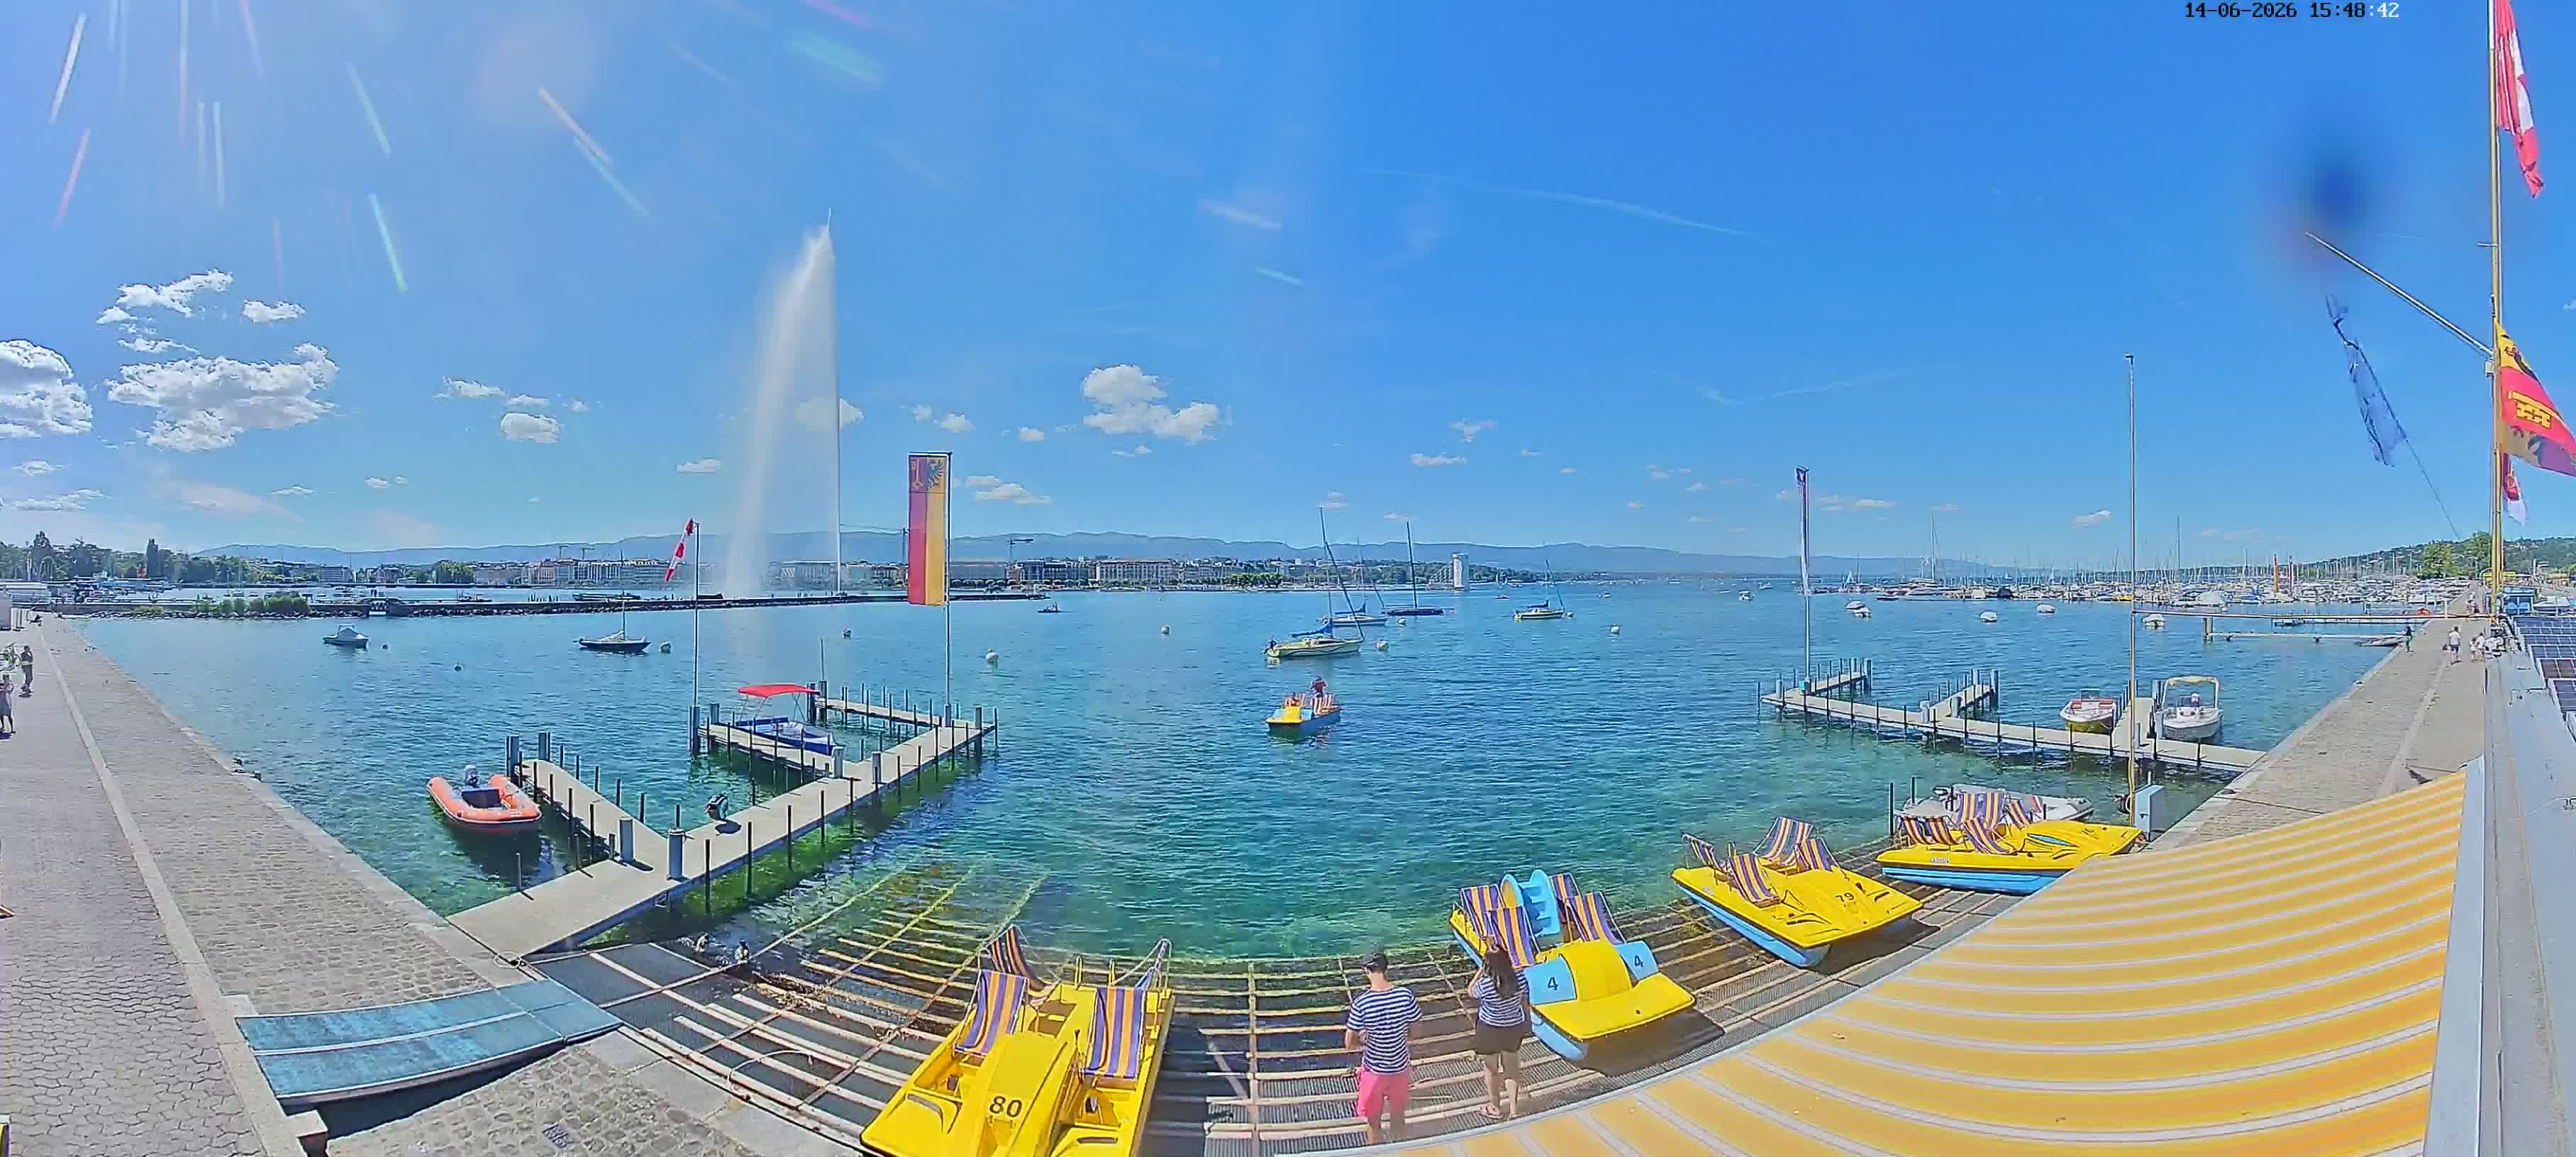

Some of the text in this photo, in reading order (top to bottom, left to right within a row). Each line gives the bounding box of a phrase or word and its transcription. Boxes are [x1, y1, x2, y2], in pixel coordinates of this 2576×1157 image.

[1835, 893, 1855, 902] 79
[1633, 955, 1644, 968] 4
[1548, 976, 1558, 990] 4
[989, 1095, 1023, 1118] 80
